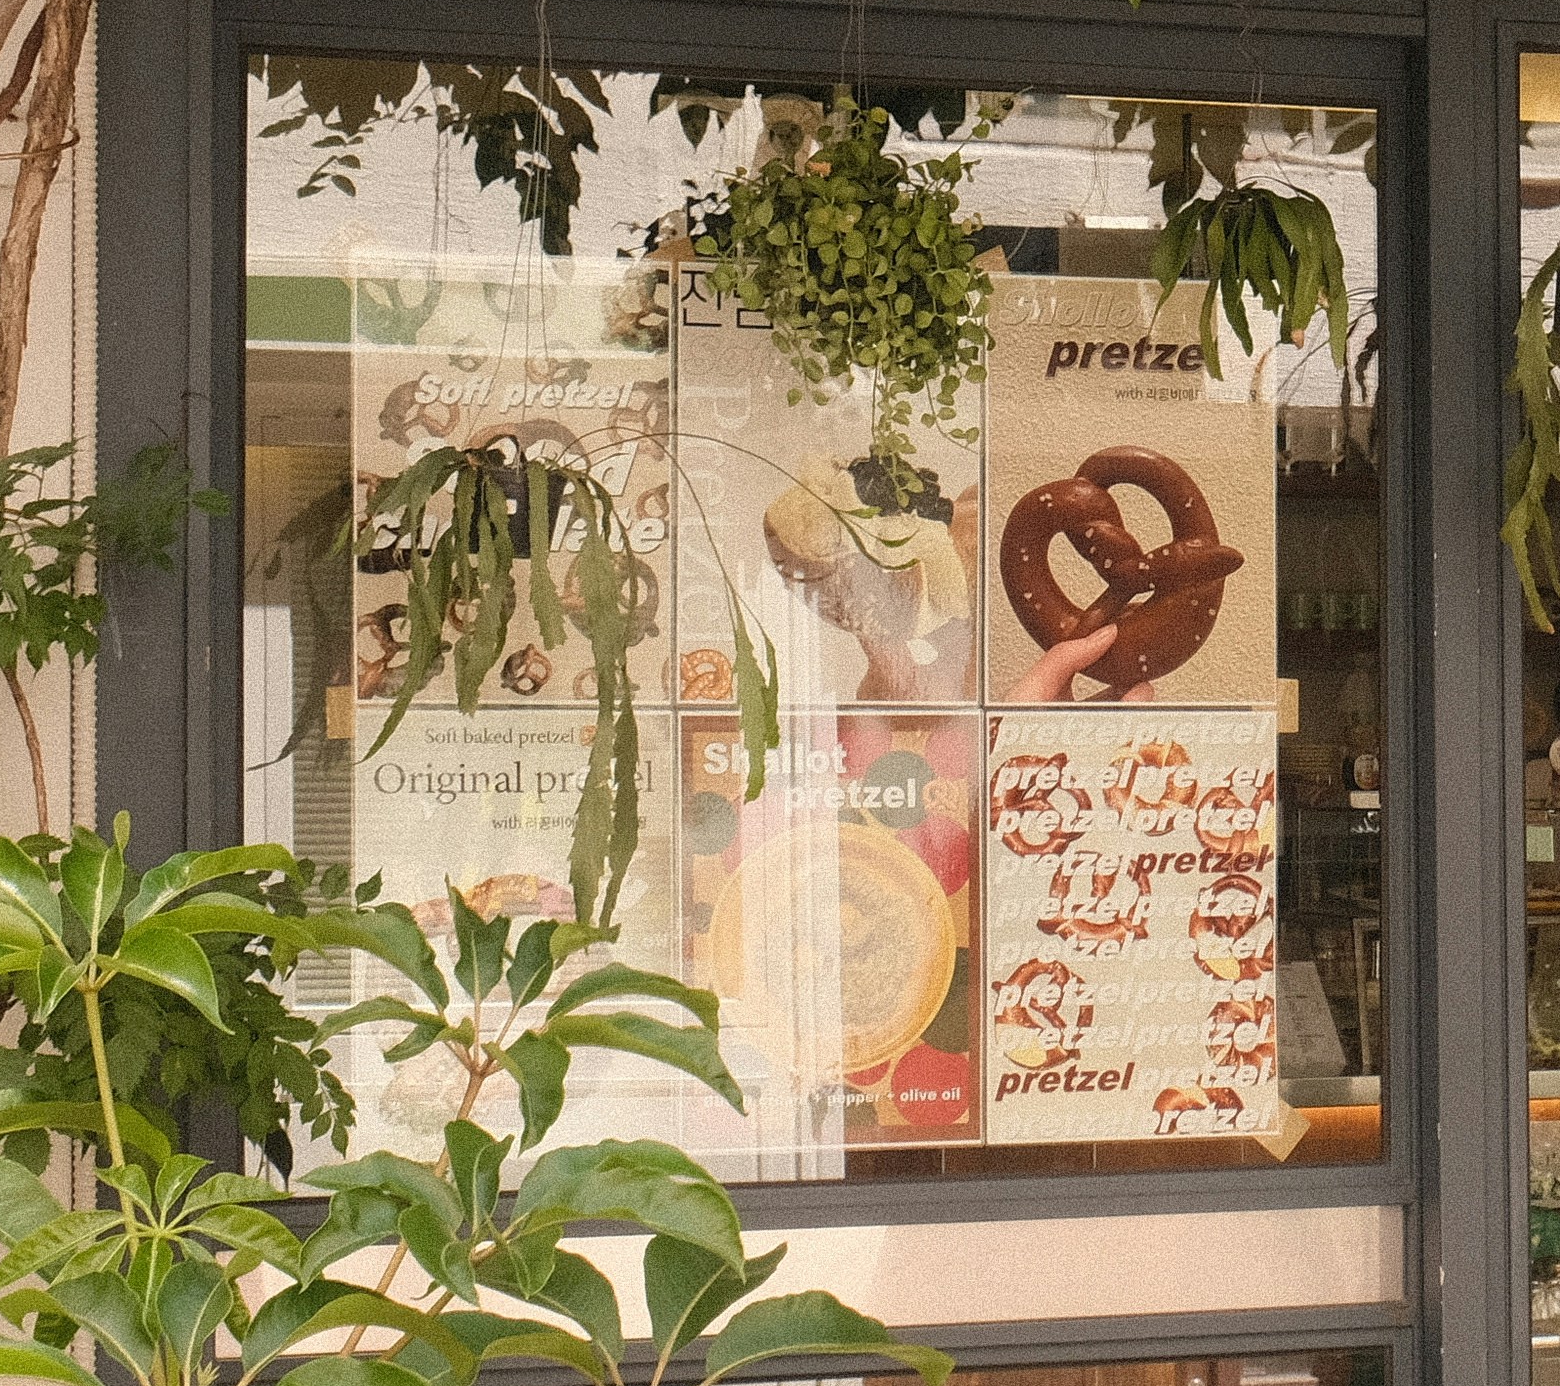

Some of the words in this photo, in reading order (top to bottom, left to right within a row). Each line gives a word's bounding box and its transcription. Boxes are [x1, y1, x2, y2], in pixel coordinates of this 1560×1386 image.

[1045, 336, 1206, 379] pretze
[414, 373, 493, 407] Soft
[499, 379, 635, 413] pretzel
[1115, 388, 1142, 400] with
[425, 729, 457, 744] Soft
[464, 729, 513, 745] baked
[519, 729, 575, 749] pretzel
[374, 761, 524, 805] Original
[784, 779, 916, 818] pretzel
[492, 817, 521, 829] with
[1132, 844, 1270, 882] pretzel
[900, 1088, 937, 1102] olive
[941, 1087, 961, 1101] oil
[995, 1062, 1135, 1102] pretzel
